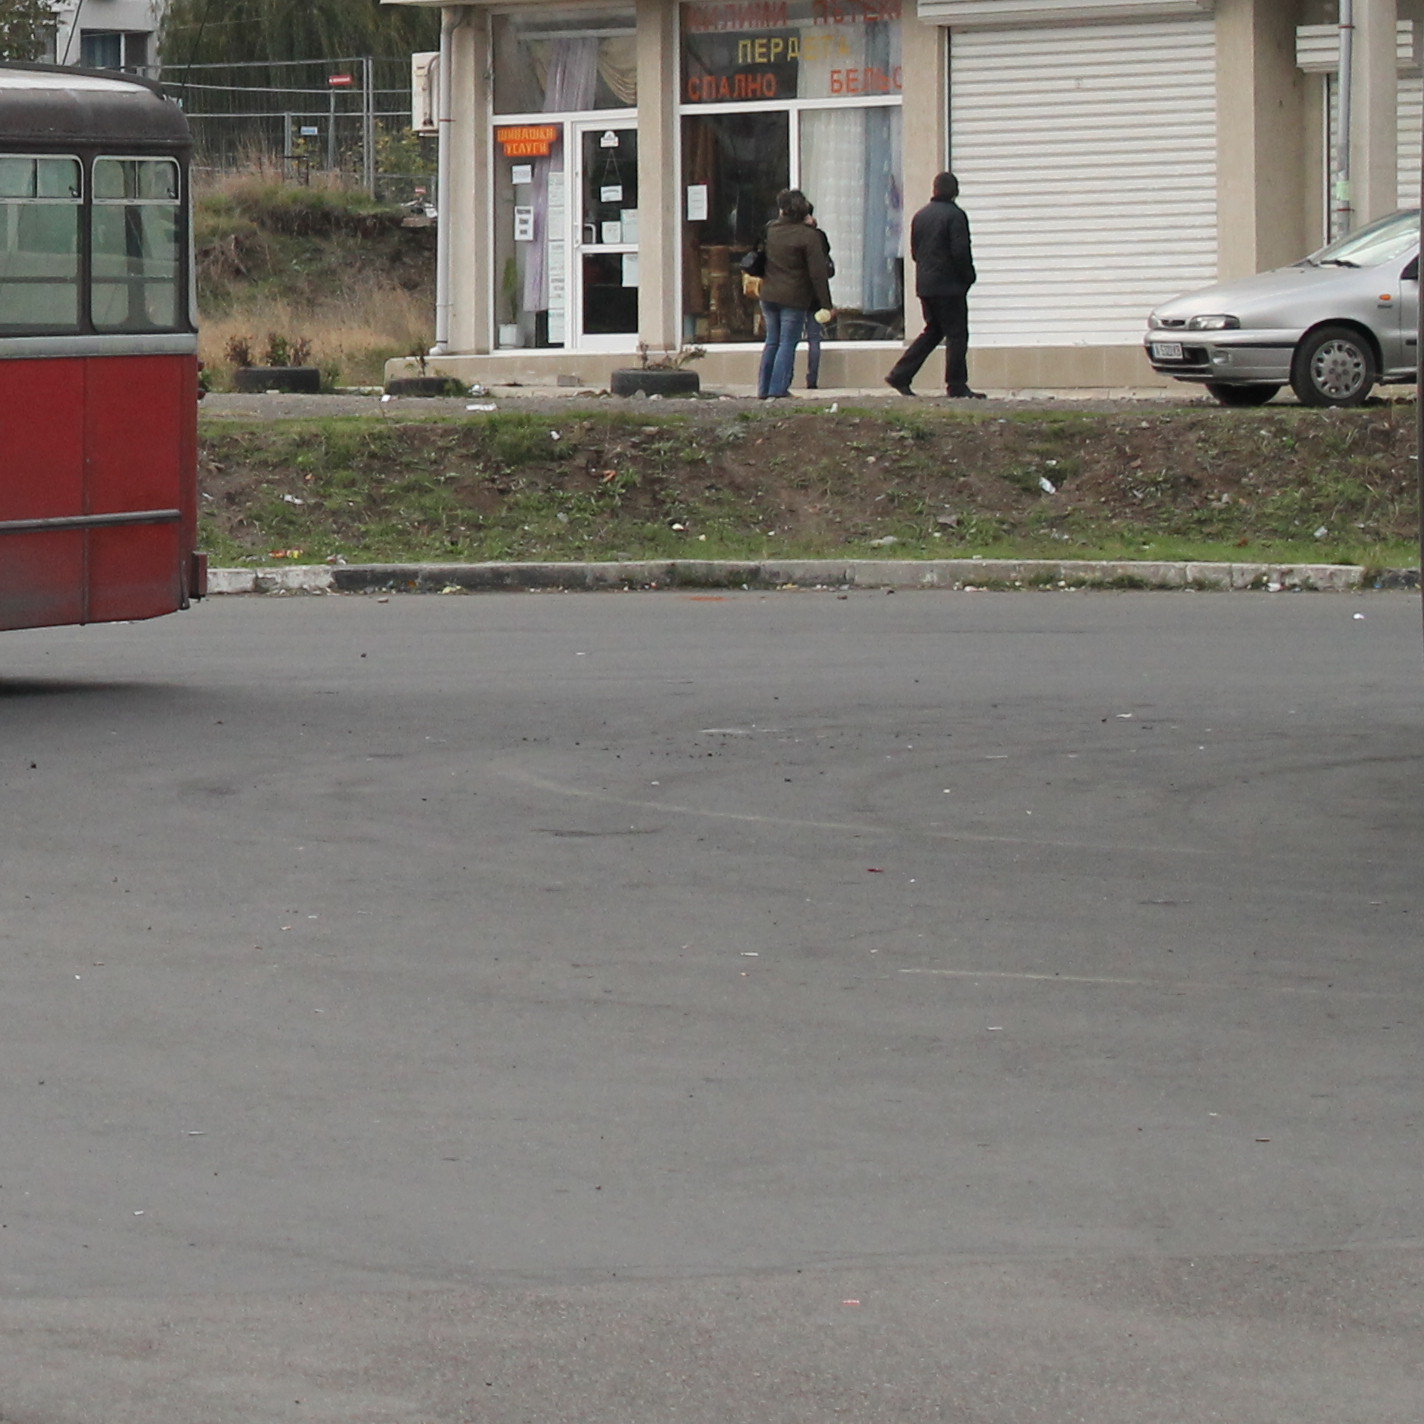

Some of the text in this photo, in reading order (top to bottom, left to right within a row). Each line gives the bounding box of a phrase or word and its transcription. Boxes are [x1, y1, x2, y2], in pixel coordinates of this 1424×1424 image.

[738, 35, 850, 63] ПЕРДЕТА
[687, 73, 778, 101] СПАЛНО
[505, 142, 547, 154] УСЛУГИ
